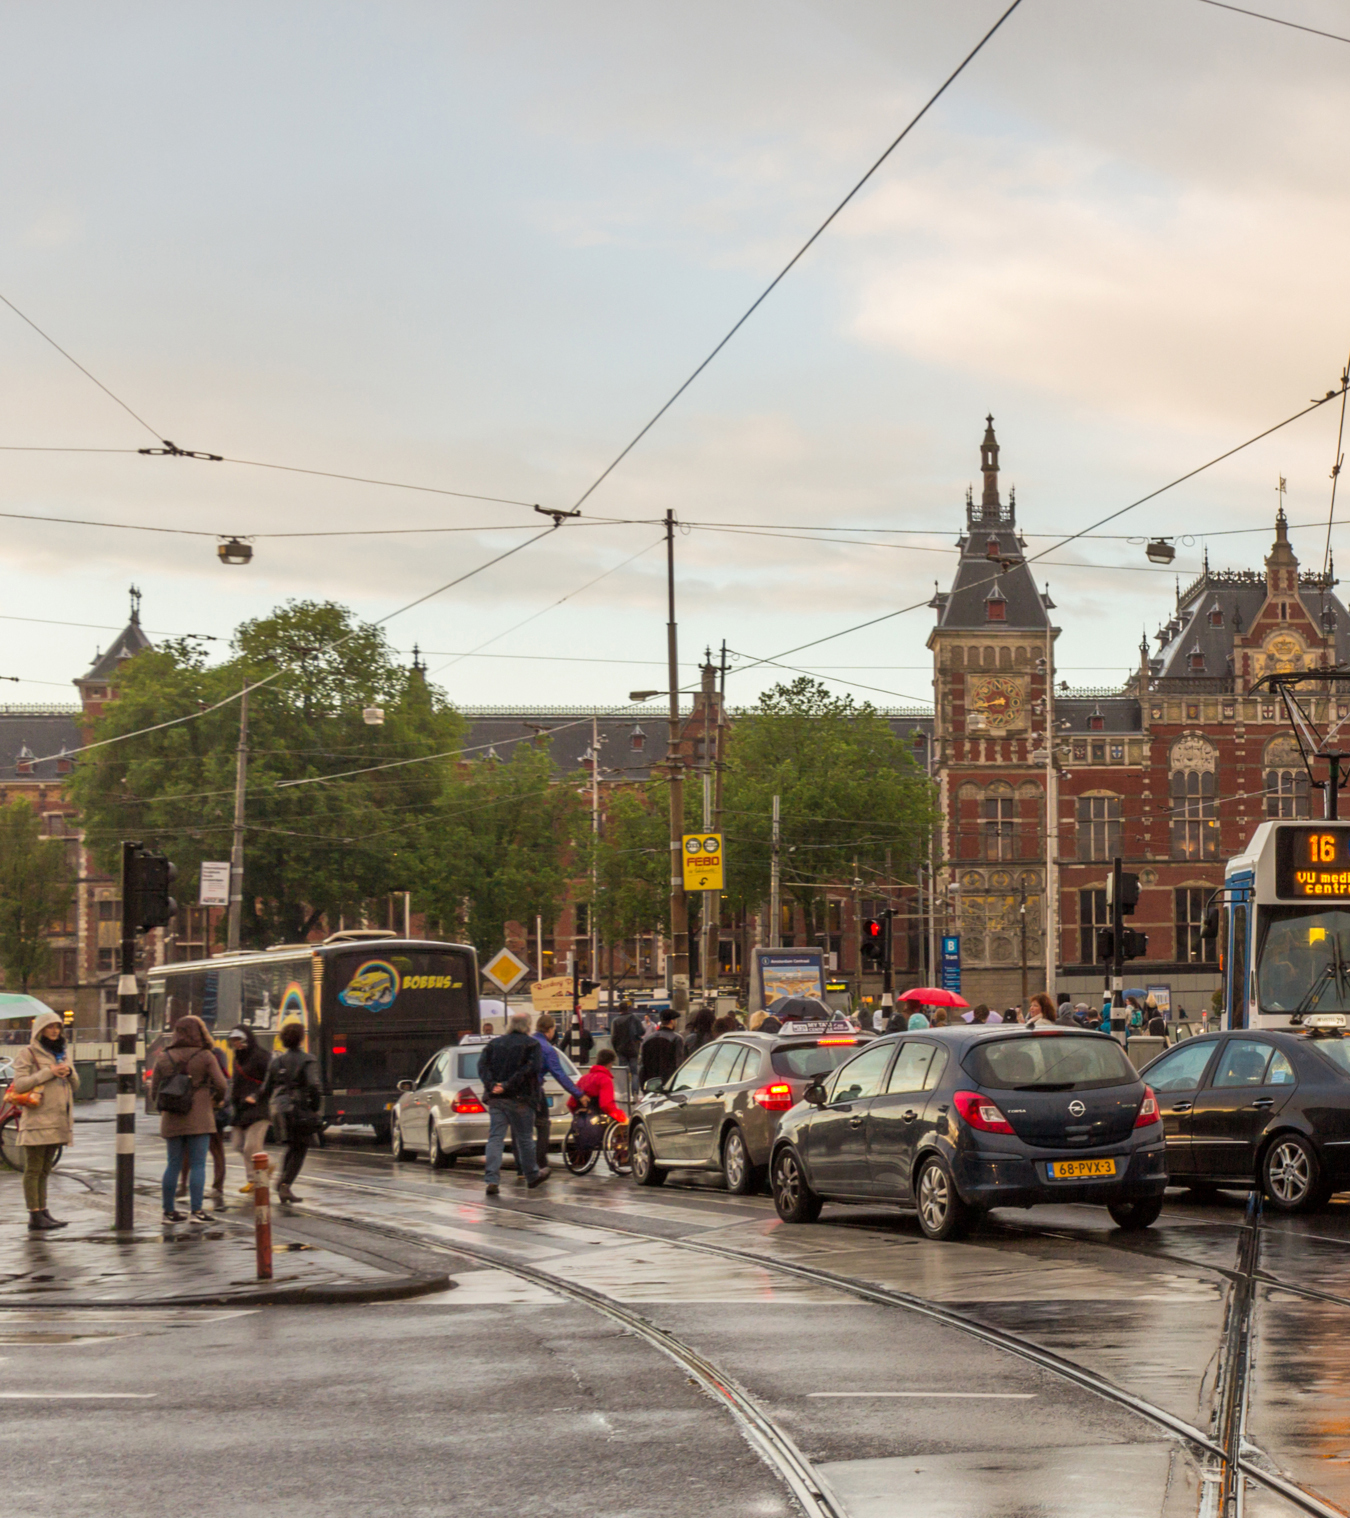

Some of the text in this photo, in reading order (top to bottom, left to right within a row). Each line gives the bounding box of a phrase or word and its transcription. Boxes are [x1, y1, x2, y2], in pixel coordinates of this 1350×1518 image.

[1309, 835, 1335, 862] 16
[686, 856, 720, 867] FEBO
[1297, 872, 1316, 884] VU
[947, 940, 955, 951] B
[1059, 1161, 1112, 1176] 68-PVX-3
